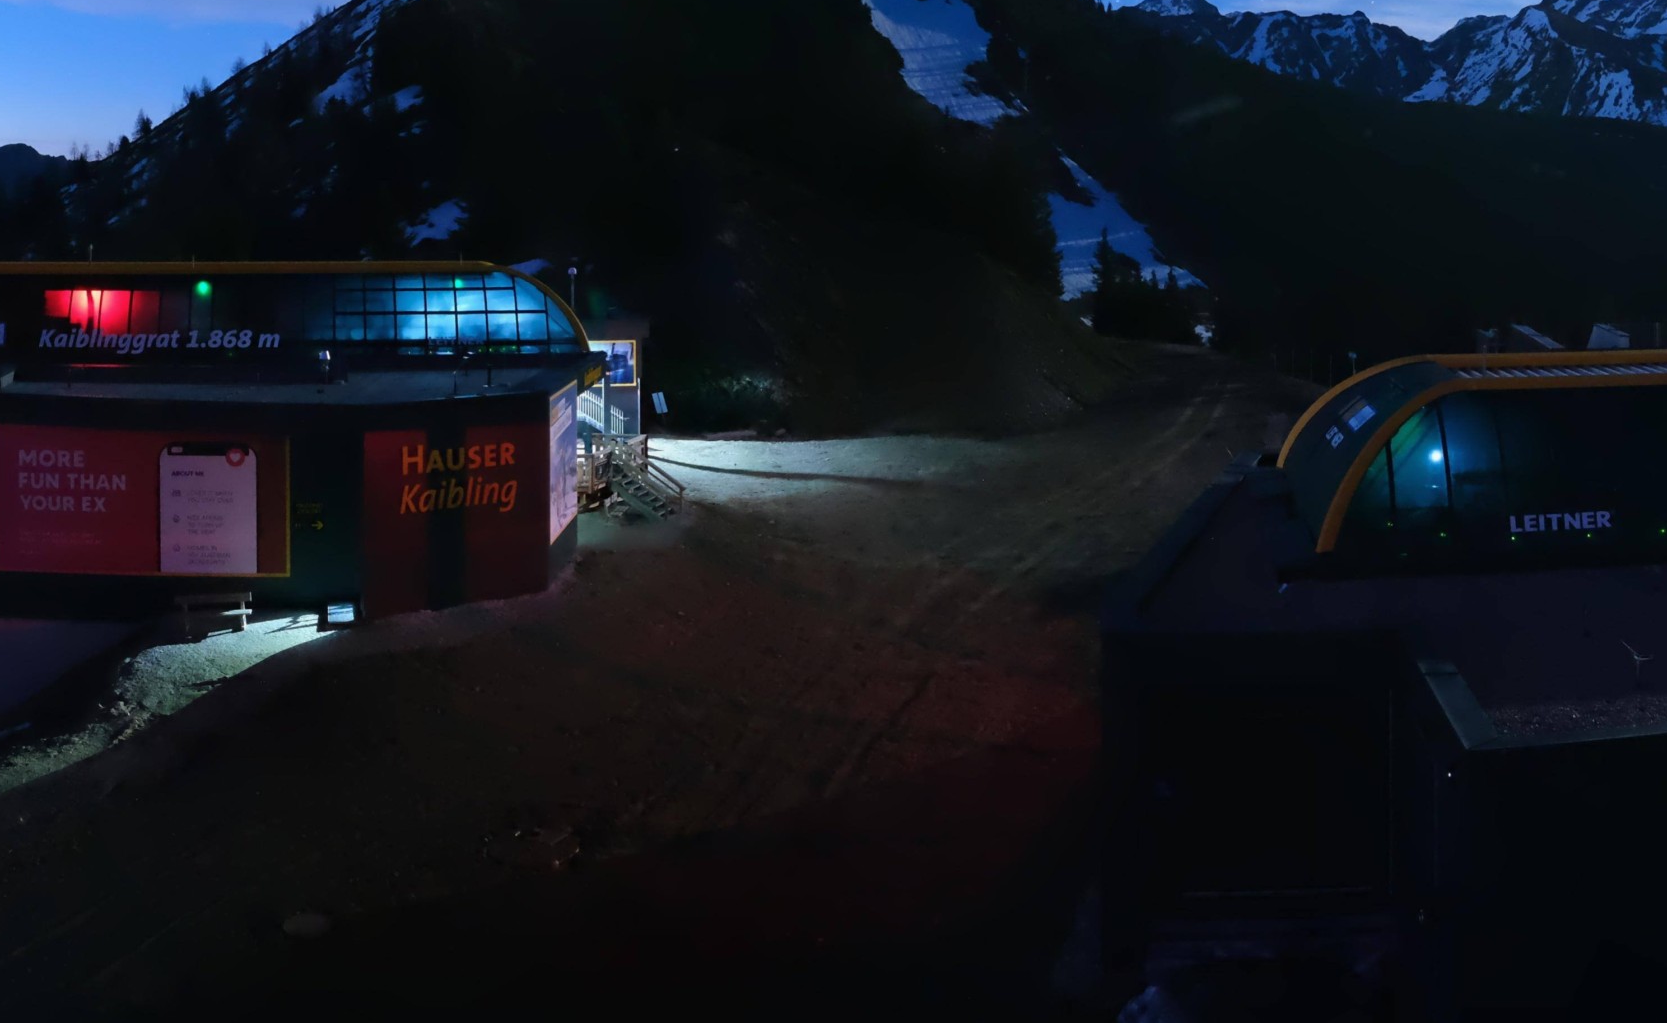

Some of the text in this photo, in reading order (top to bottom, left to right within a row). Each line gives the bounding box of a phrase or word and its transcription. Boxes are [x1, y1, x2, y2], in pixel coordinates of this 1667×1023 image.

[38, 329, 281, 355] Kaiblinggrat 1.868 m
[18, 449, 85, 468] MORE
[402, 441, 516, 475] HAUSER
[18, 472, 126, 491] FUN THAN
[20, 494, 107, 513] YOUR EX
[400, 476, 518, 514] Kaibling
[1509, 510, 1612, 533] LEITNER
